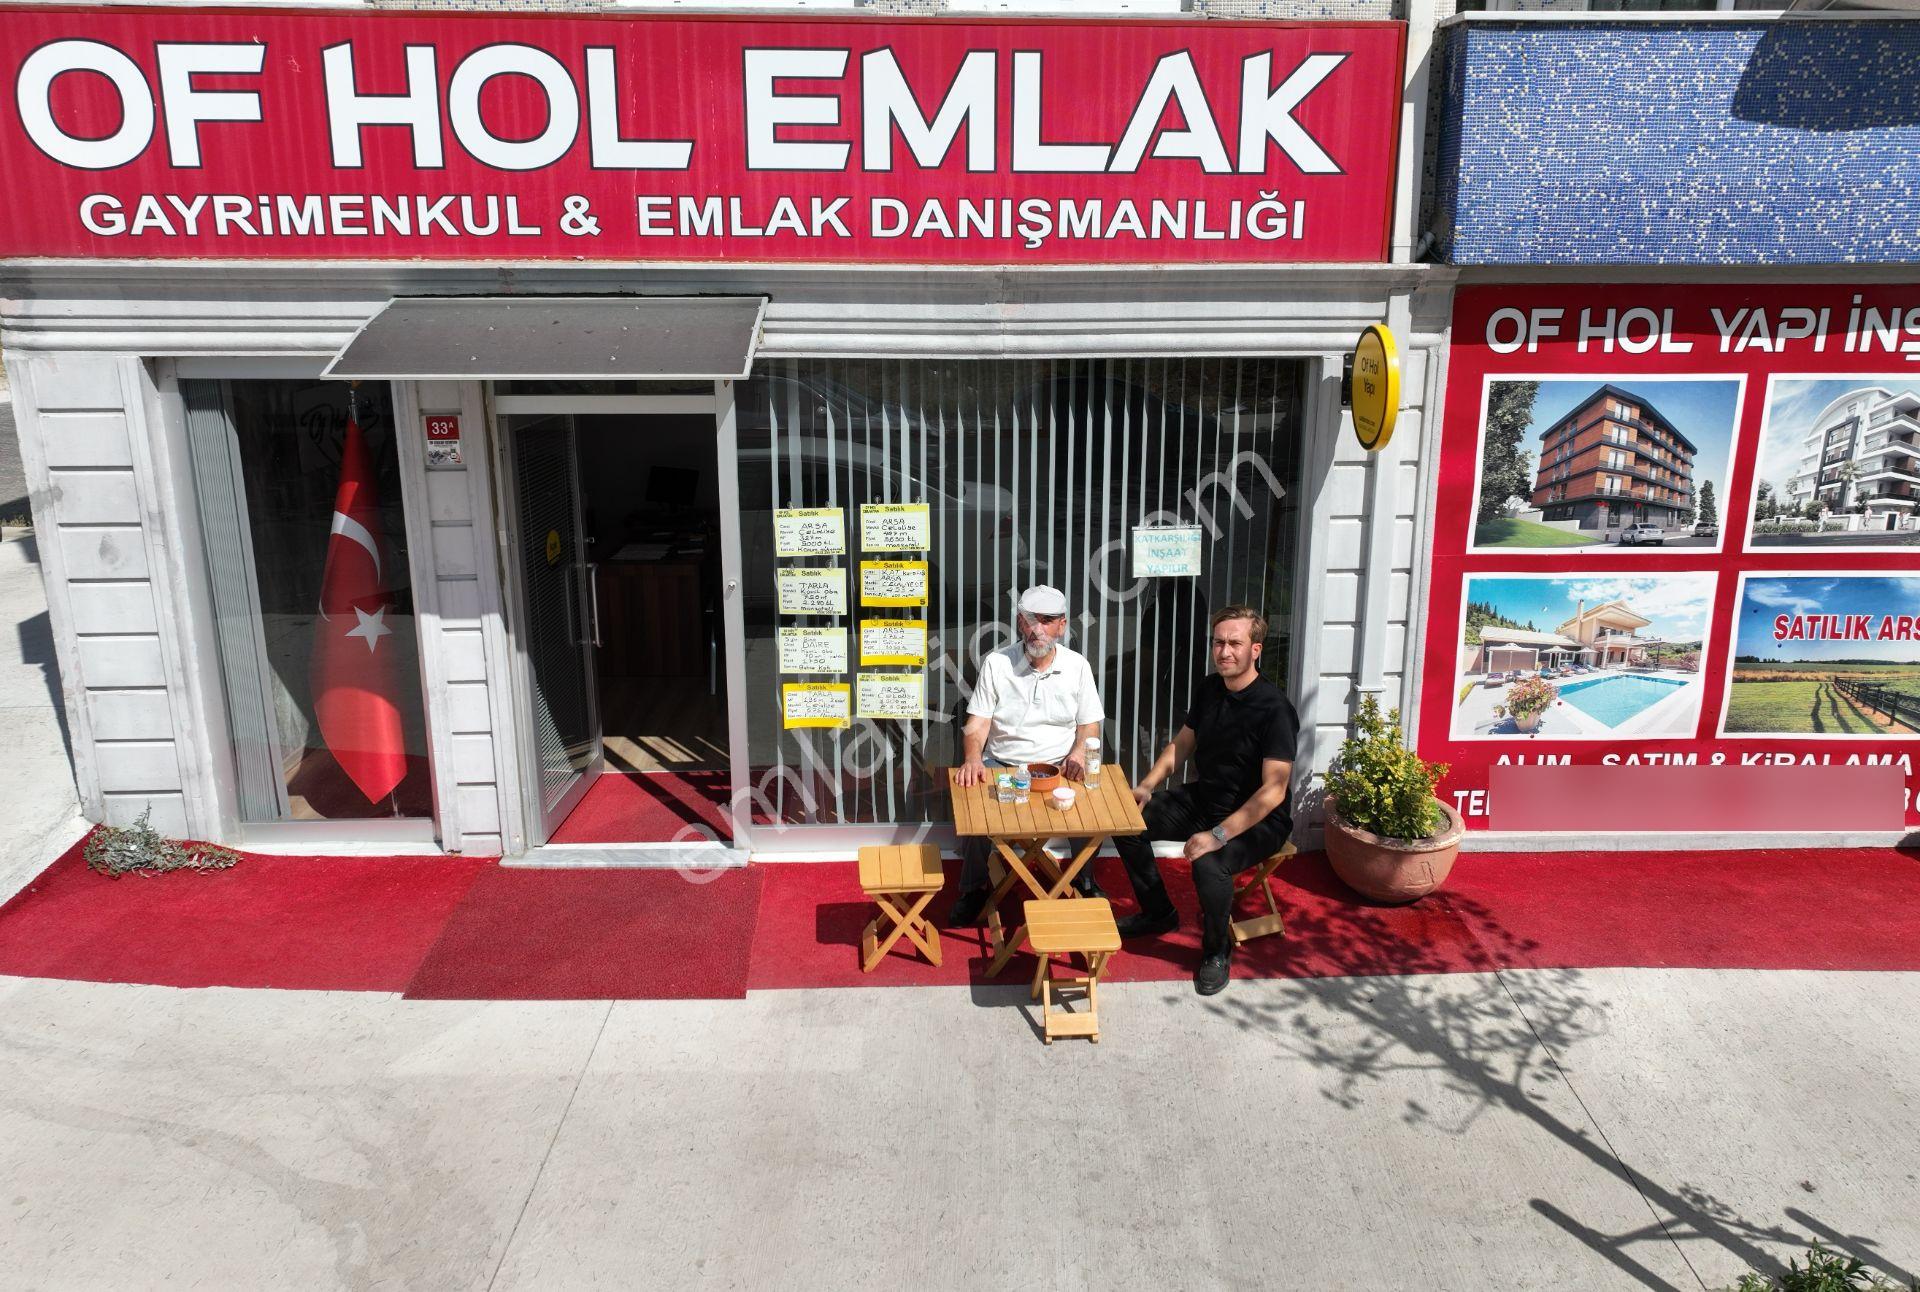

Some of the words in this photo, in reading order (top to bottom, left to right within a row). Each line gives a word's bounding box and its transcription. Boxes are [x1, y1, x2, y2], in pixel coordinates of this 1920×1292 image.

[17, 39, 267, 171] OF
[322, 39, 695, 171] HOL
[743, 46, 1352, 175] EMLAK
[559, 195, 602, 238] &
[638, 196, 852, 239] EMLAK
[871, 190, 1305, 249] DANIŞMANLIĞI
[1486, 307, 1565, 354] OF
[1577, 307, 1694, 354] HOL
[1710, 307, 1831, 353] YAPI
[1773, 614, 1874, 641] SATILIK
